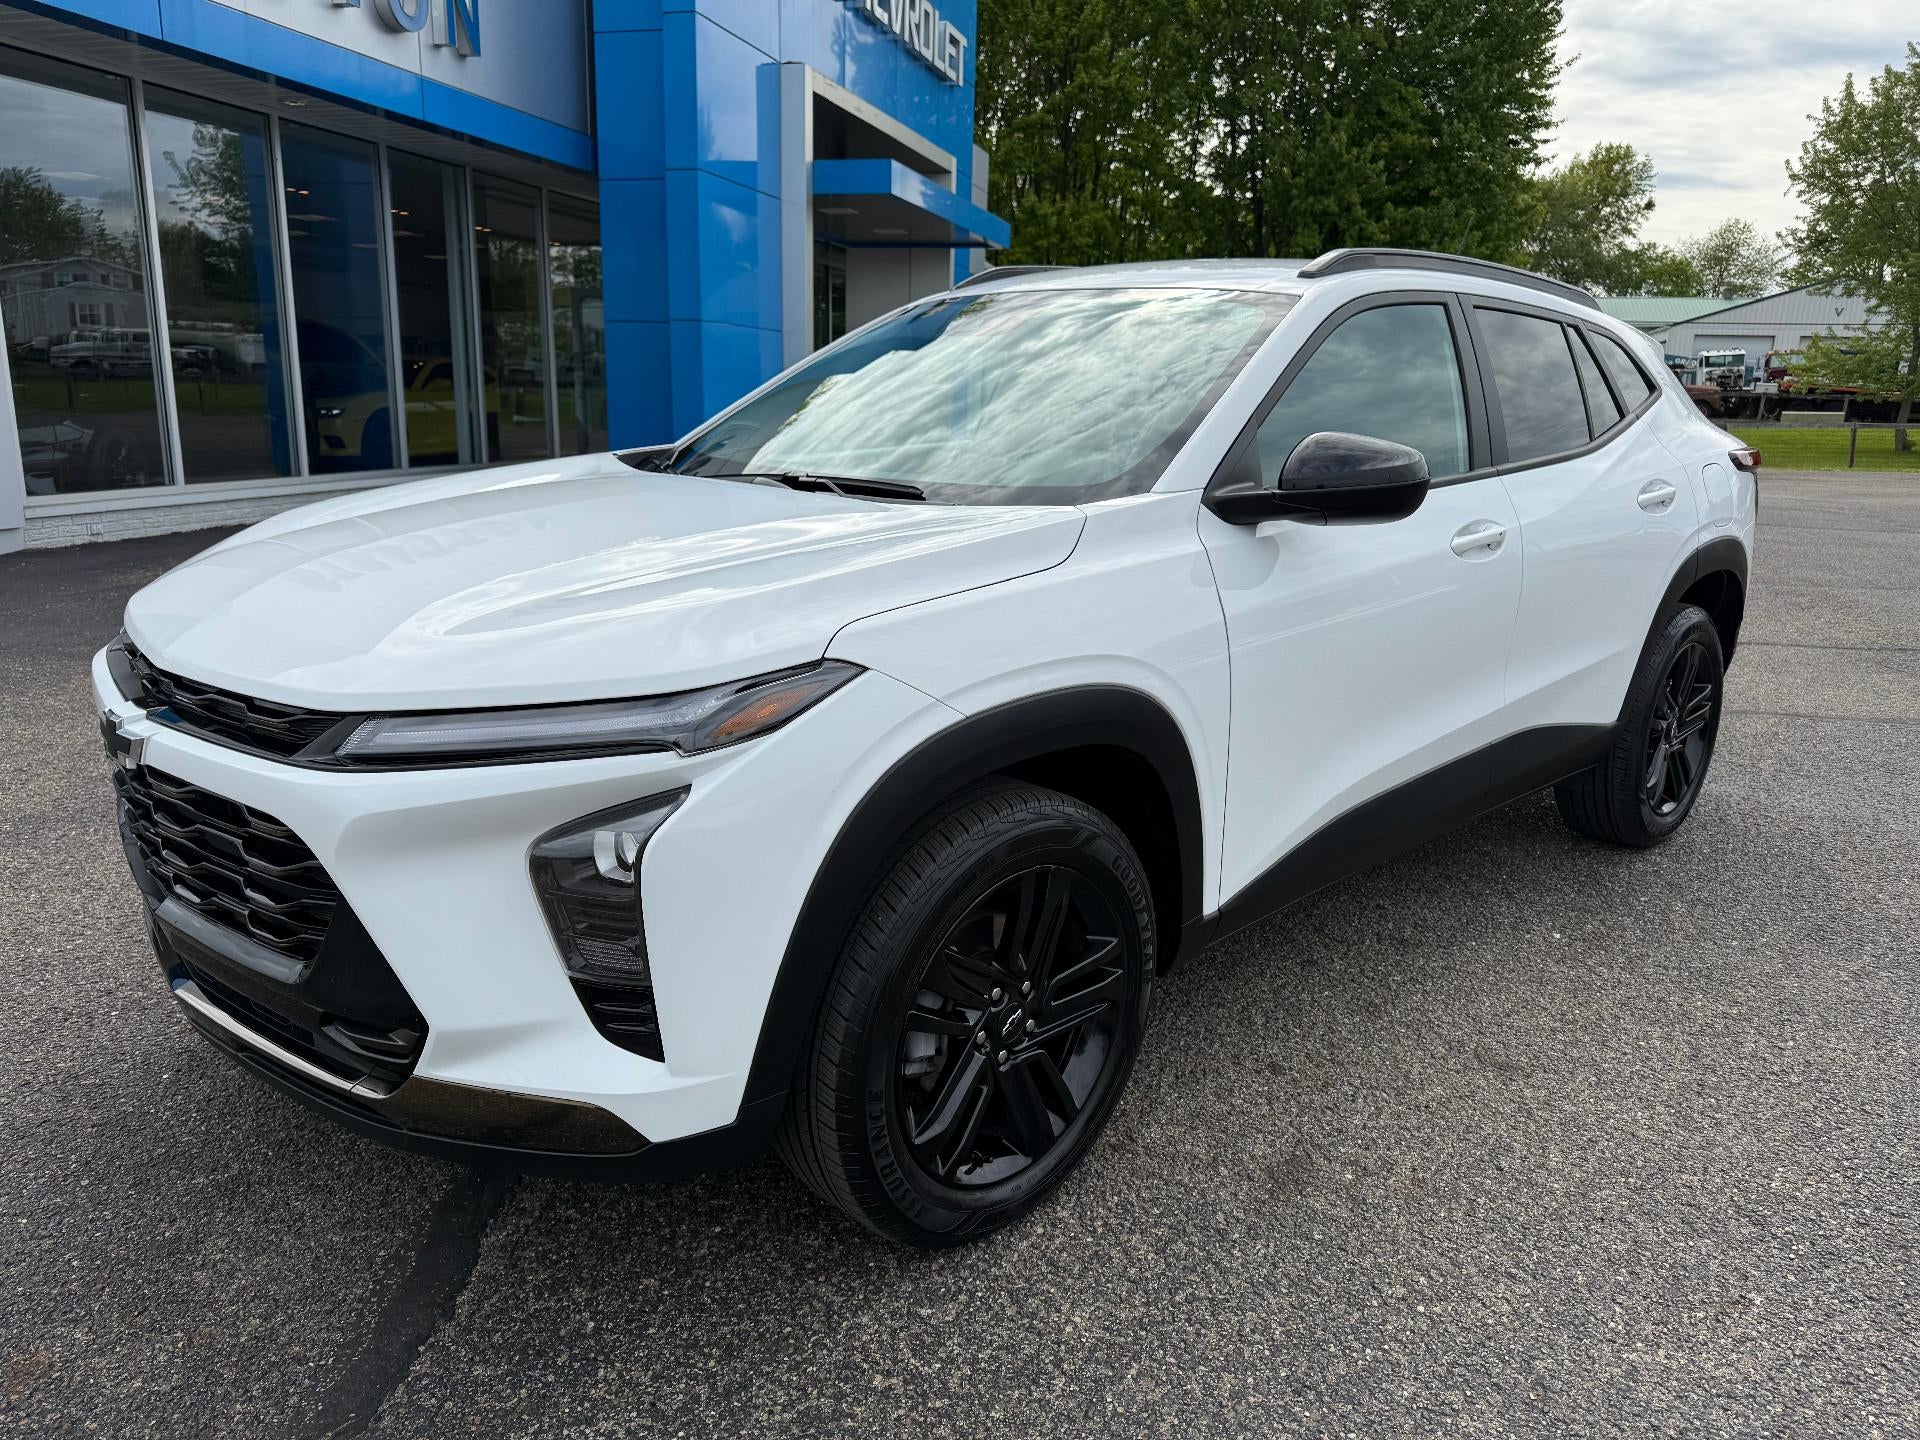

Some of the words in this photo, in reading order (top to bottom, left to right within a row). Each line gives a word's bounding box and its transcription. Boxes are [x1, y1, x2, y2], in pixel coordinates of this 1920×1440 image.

[864, 0, 967, 88] VROLET
[1111, 854, 1153, 984] GOODYEAR
[868, 1088, 927, 1217] ASSURANCE
